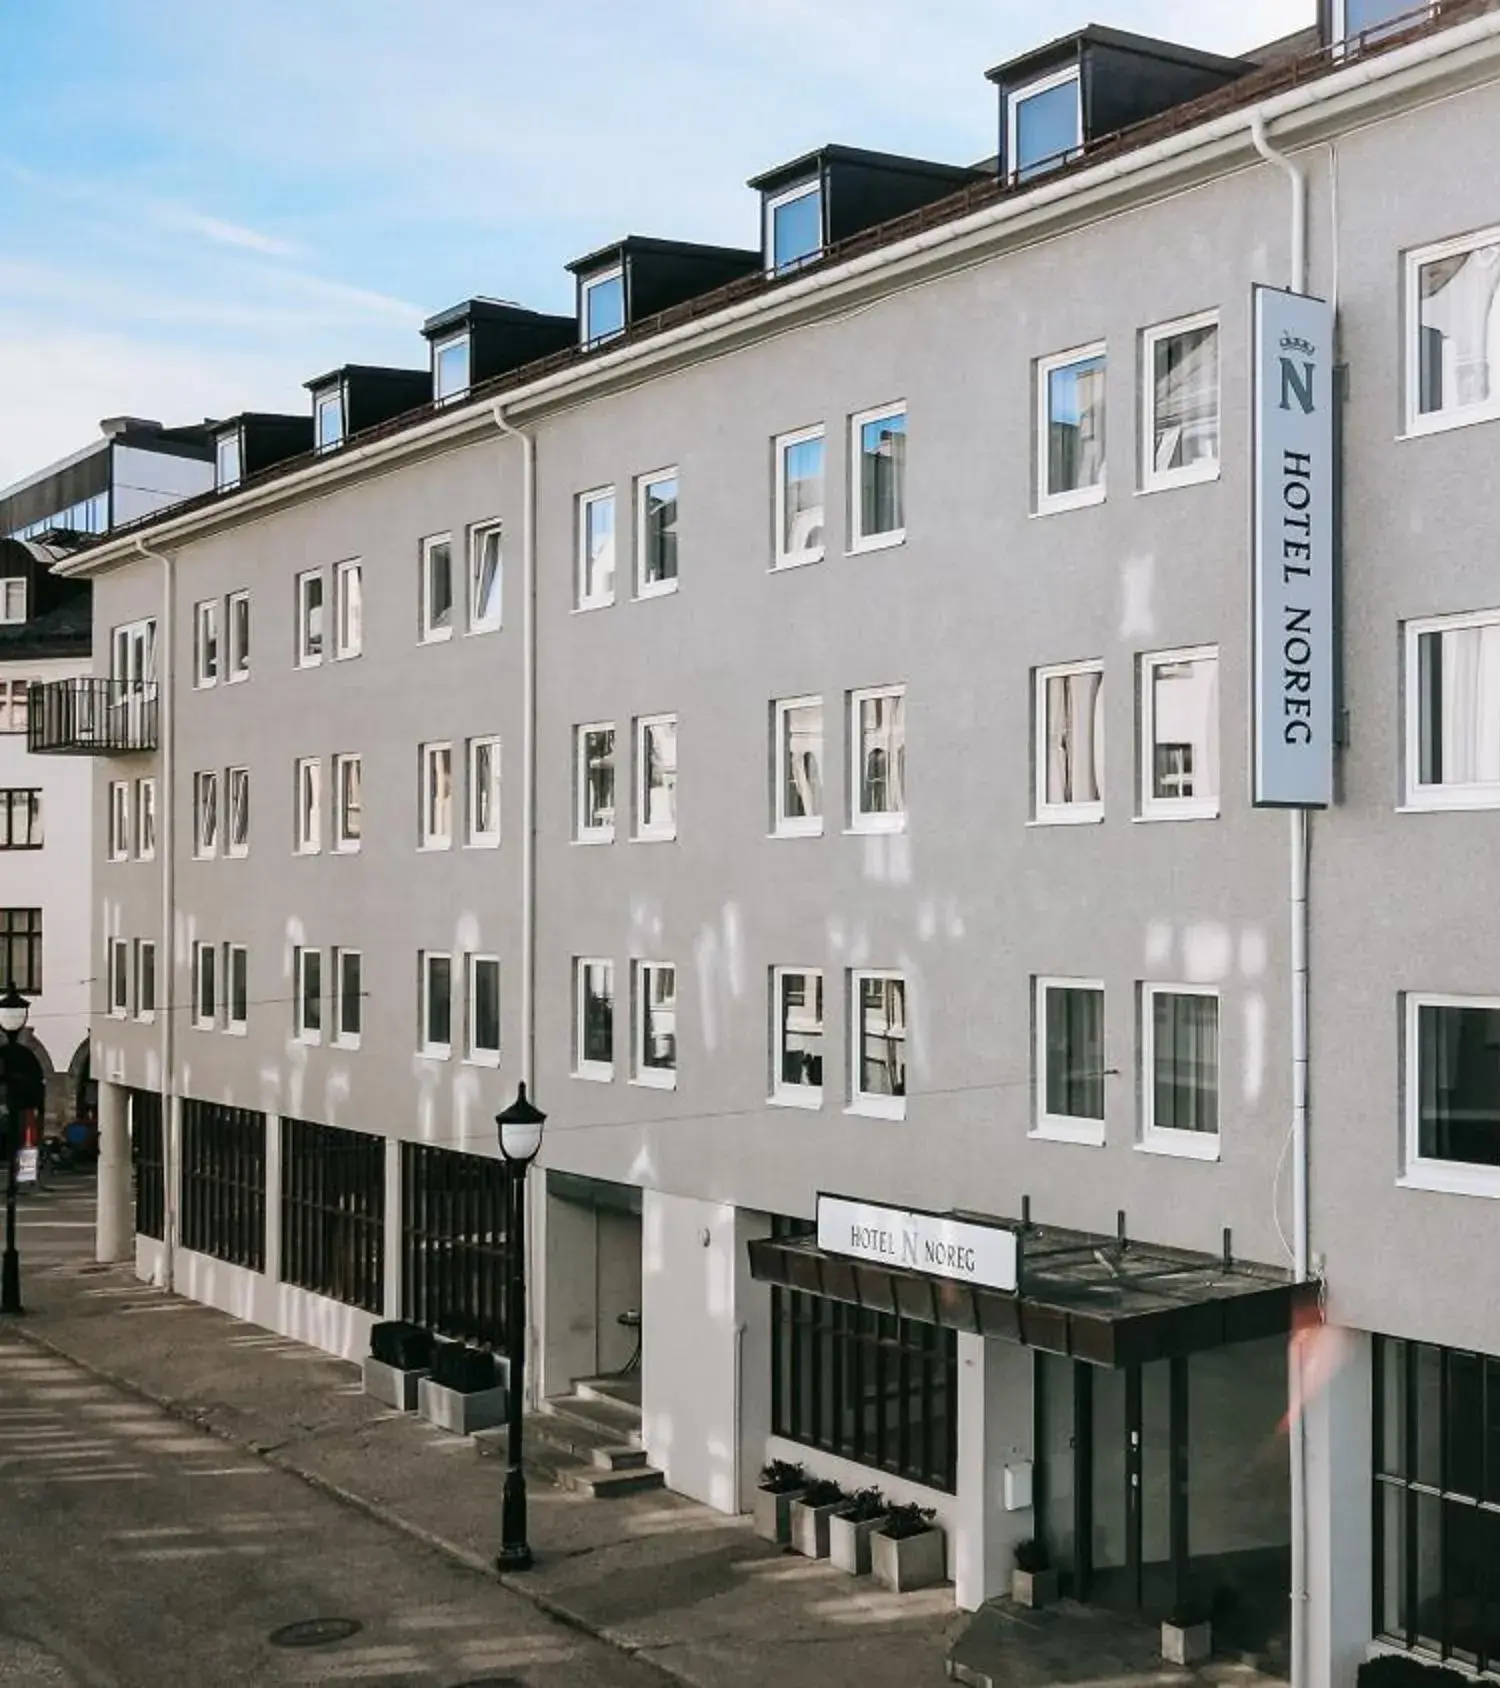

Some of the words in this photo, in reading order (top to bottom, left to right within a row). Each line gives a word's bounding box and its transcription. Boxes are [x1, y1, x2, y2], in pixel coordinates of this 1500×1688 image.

[1279, 357, 1316, 415] N
[1283, 449, 1312, 585] HOTEL
[1283, 606, 1312, 746] NOREG
[850, 1224, 896, 1256] HOTEL
[902, 1229, 920, 1265] N
[924, 1238, 976, 1273] NOREG
